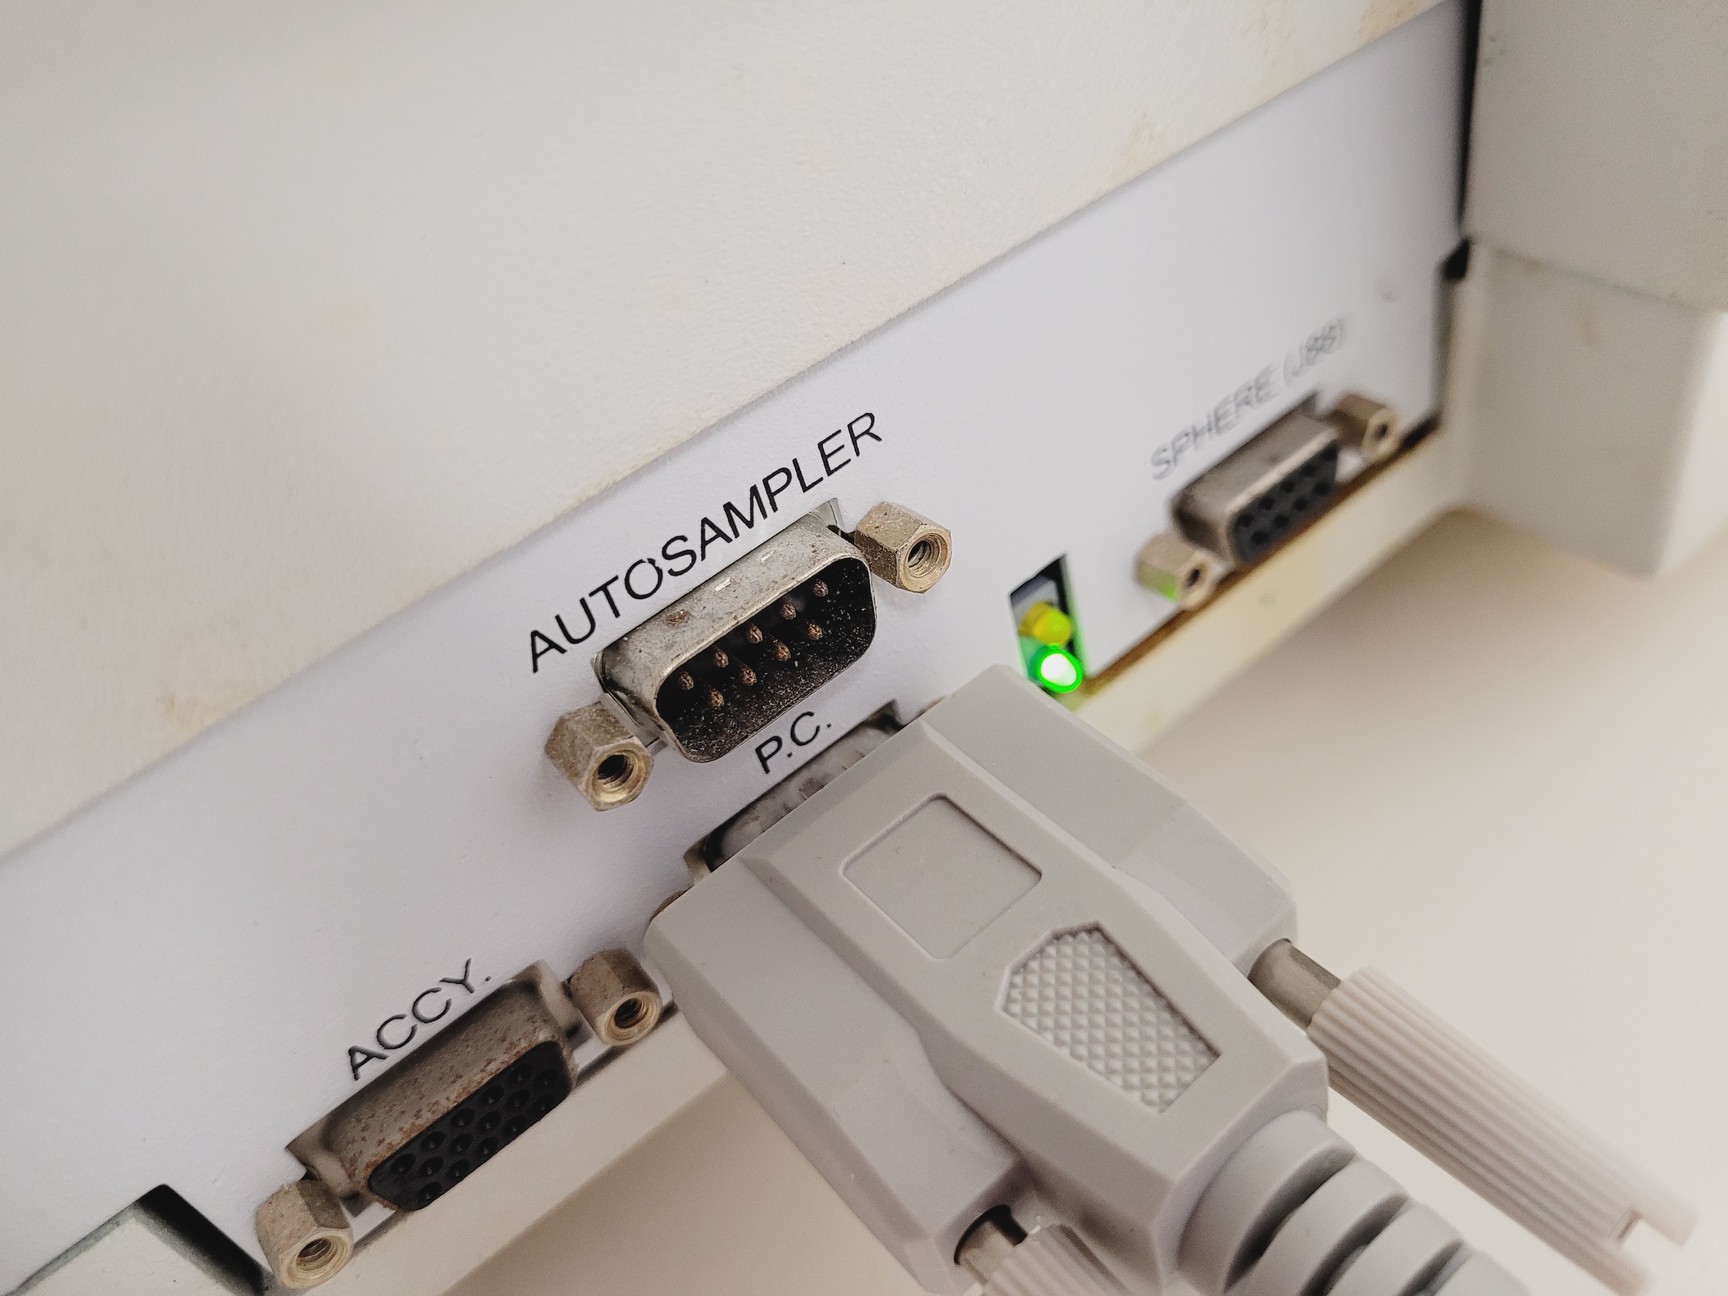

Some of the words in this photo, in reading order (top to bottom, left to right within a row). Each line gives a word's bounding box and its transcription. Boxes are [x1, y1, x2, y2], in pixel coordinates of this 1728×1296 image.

[1151, 361, 1281, 480] SPHERE
[531, 412, 882, 673] AUTOSAMPLER
[755, 711, 832, 774] P.C.
[348, 957, 492, 1081] ACCY.
